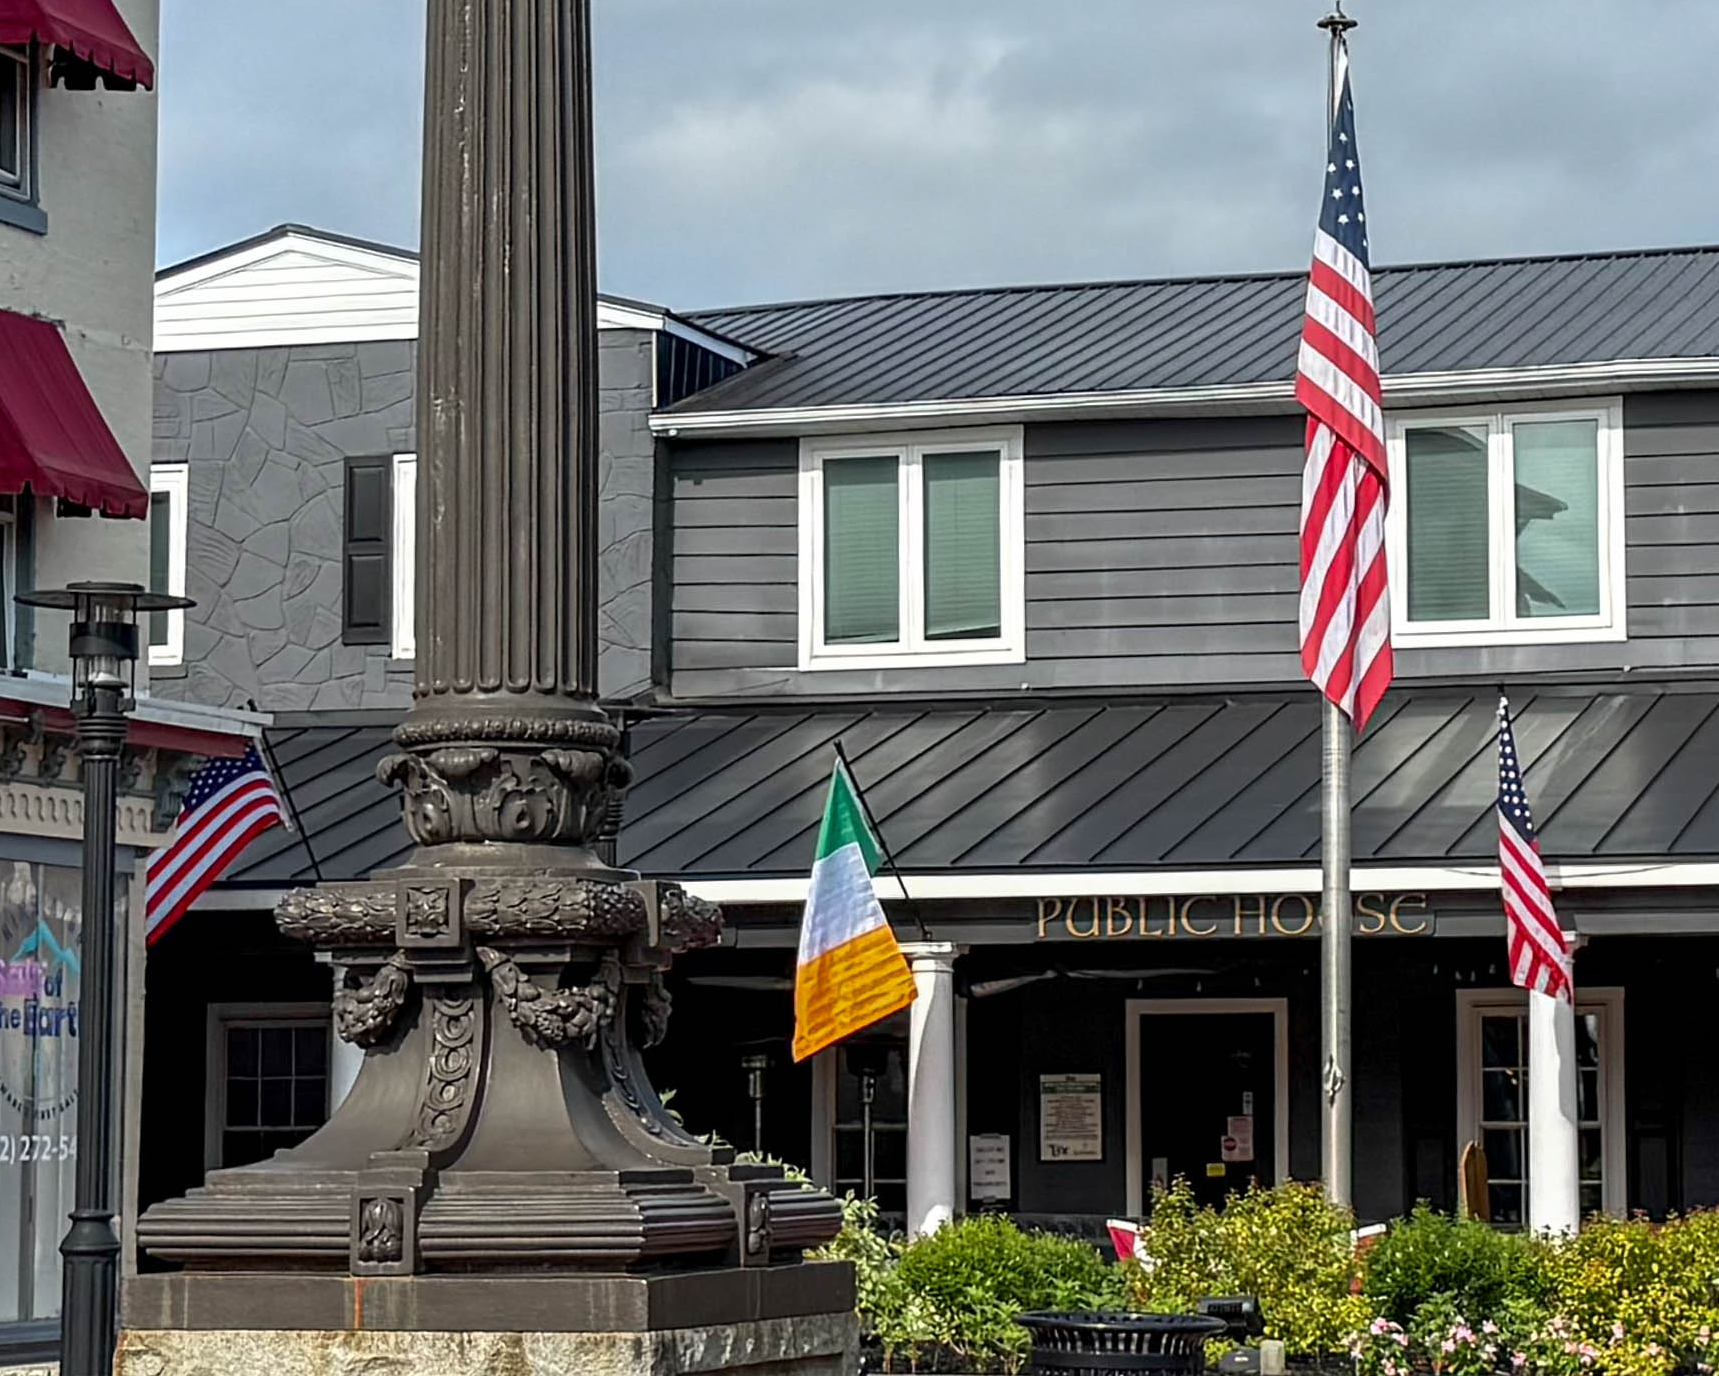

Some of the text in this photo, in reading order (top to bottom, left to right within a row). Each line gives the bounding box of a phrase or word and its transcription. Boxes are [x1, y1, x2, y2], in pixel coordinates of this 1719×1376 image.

[1036, 892, 1428, 939] PUBLIC HOSE
[44, 968, 62, 997] of
[23, 998, 78, 1037] Eart
